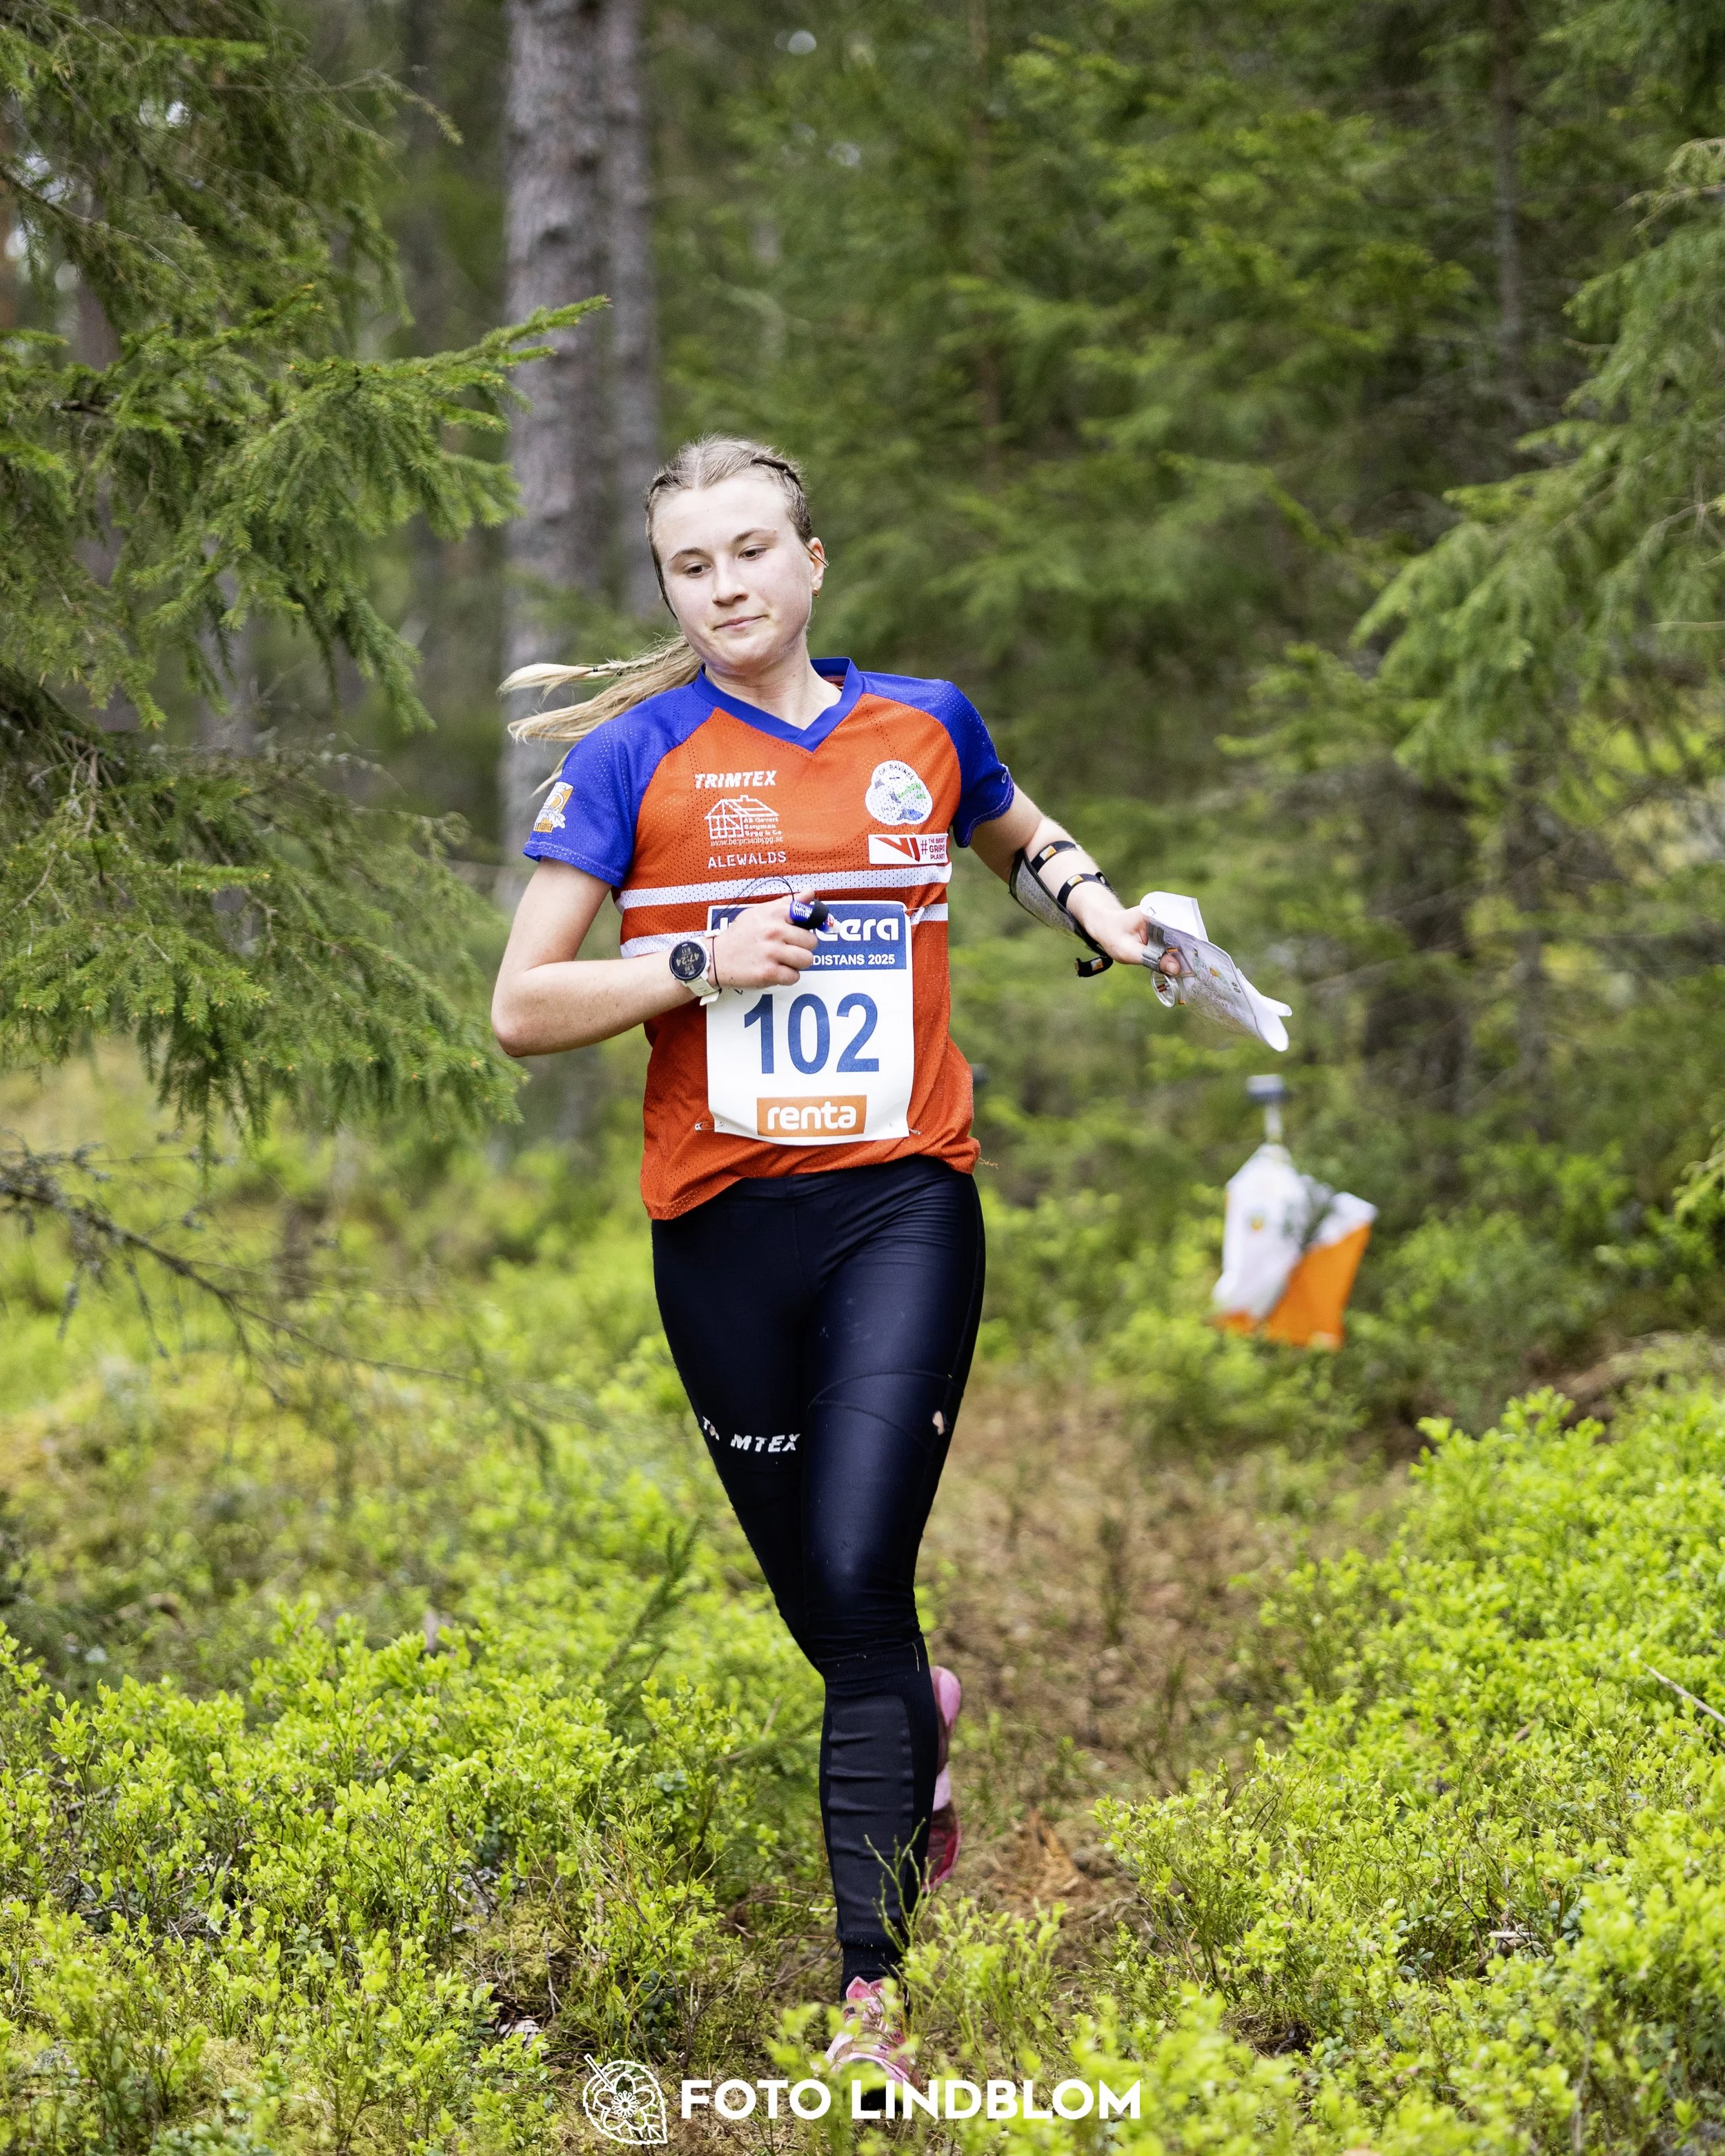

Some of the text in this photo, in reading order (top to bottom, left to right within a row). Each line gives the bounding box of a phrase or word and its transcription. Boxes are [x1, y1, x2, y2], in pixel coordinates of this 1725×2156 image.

[694, 770, 777, 789] TRIMTEX
[707, 851, 787, 869] ALEWALDS
[811, 953, 896, 966] DISTANS 2025
[744, 993, 879, 1074] 102
[767, 1101, 857, 1131] renta
